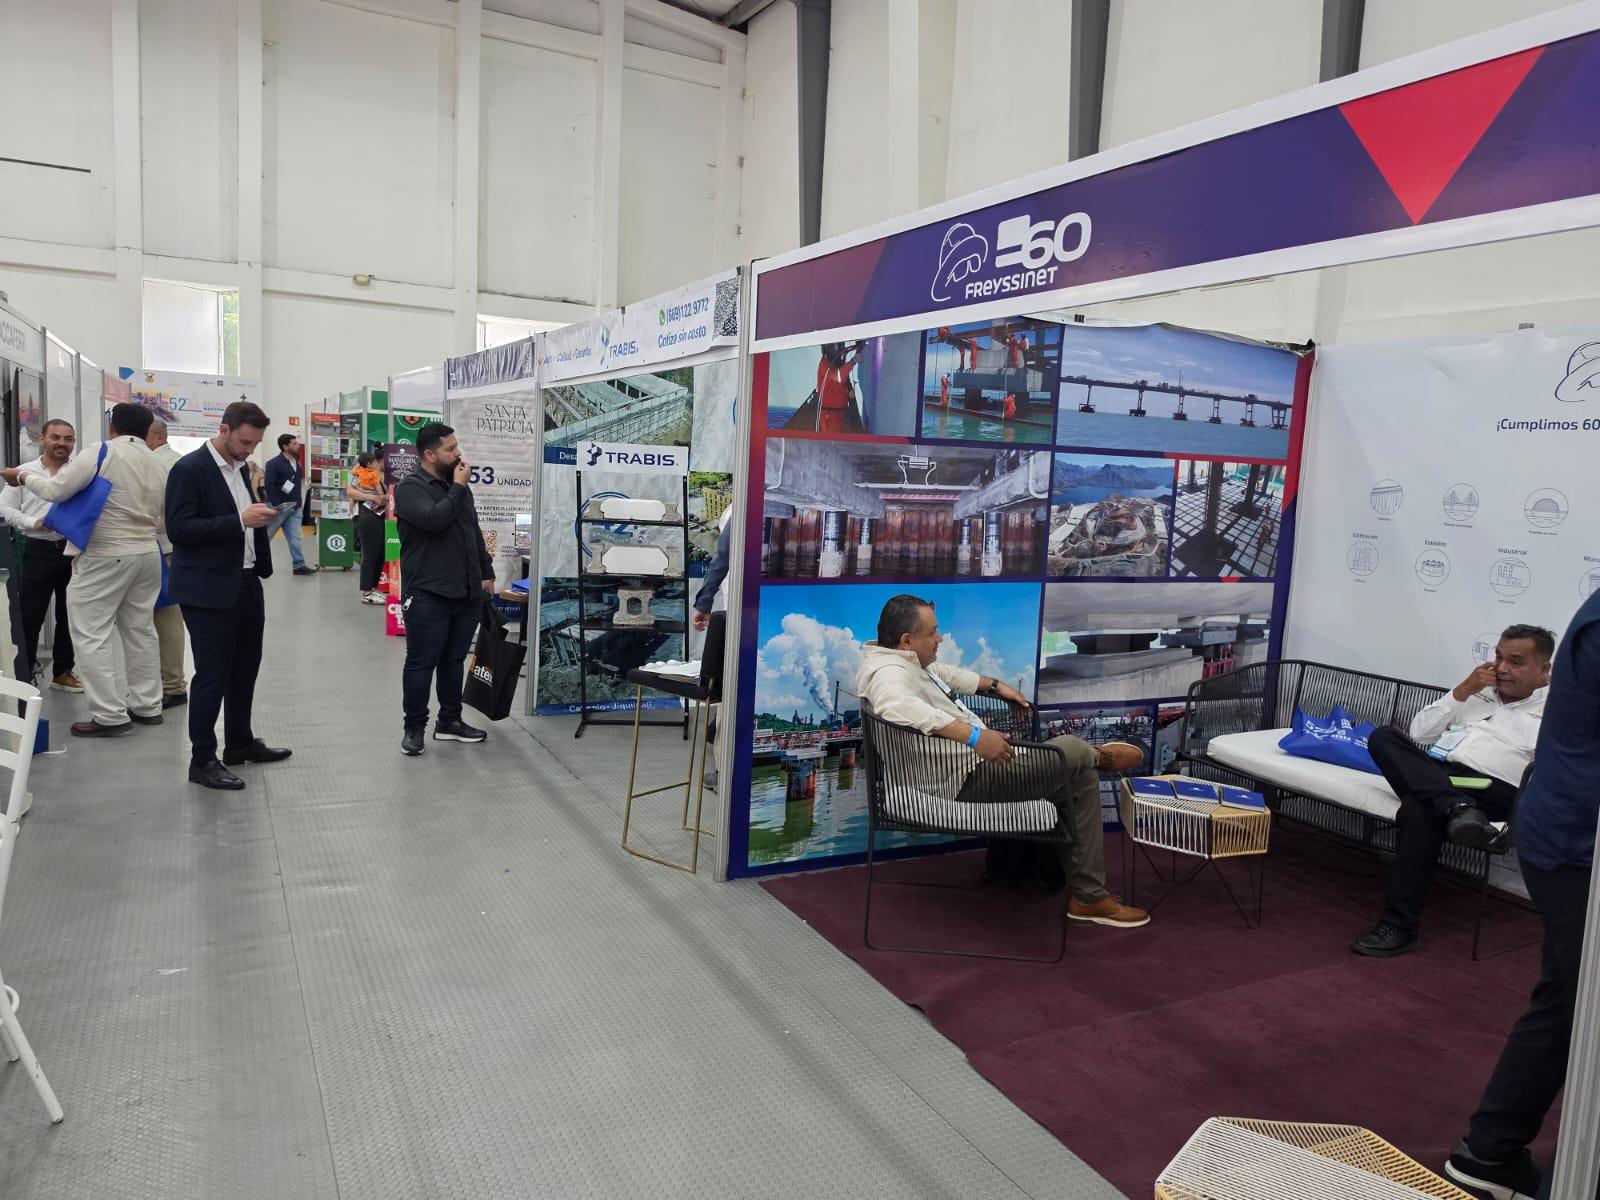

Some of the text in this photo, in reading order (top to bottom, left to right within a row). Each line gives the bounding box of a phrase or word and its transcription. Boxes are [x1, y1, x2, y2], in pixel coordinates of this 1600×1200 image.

[692, 297, 709, 315] 9772
[658, 325, 707, 348] Cotiza sin costo
[609, 341, 637, 358] TRABIS
[485, 404, 526, 419] SANTA
[477, 418, 534, 434] PATRICIA
[1496, 418, 1579, 432] ¡Cumplimos
[605, 451, 676, 466] TRABIS
[469, 465, 534, 487] 53 UNIDAD
[1498, 548, 1528, 556] Industrial
